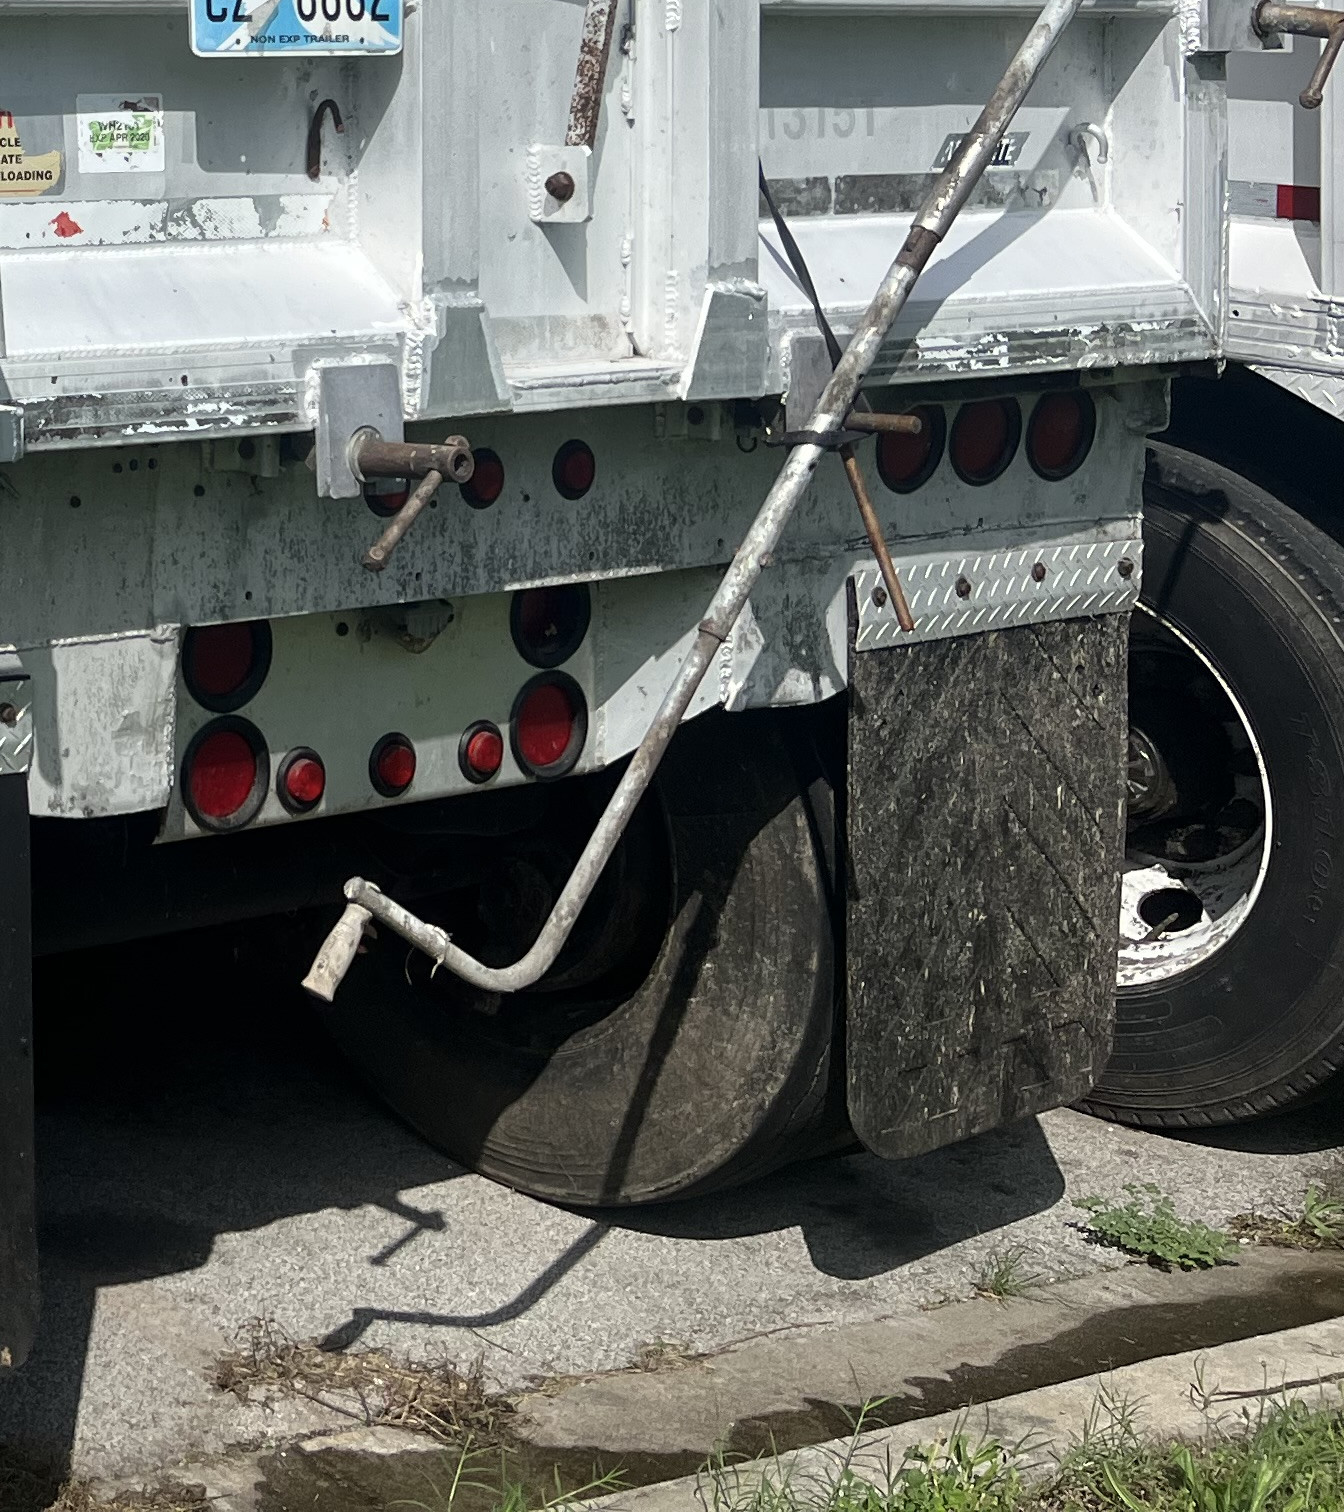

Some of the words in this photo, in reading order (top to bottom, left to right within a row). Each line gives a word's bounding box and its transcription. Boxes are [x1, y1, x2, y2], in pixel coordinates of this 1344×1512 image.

[250, 34, 276, 44] NON
[279, 34, 301, 44] EXP
[304, 33, 350, 44] TRAILER
[0, 137, 22, 148] CLE
[109, 132, 128, 142] APR
